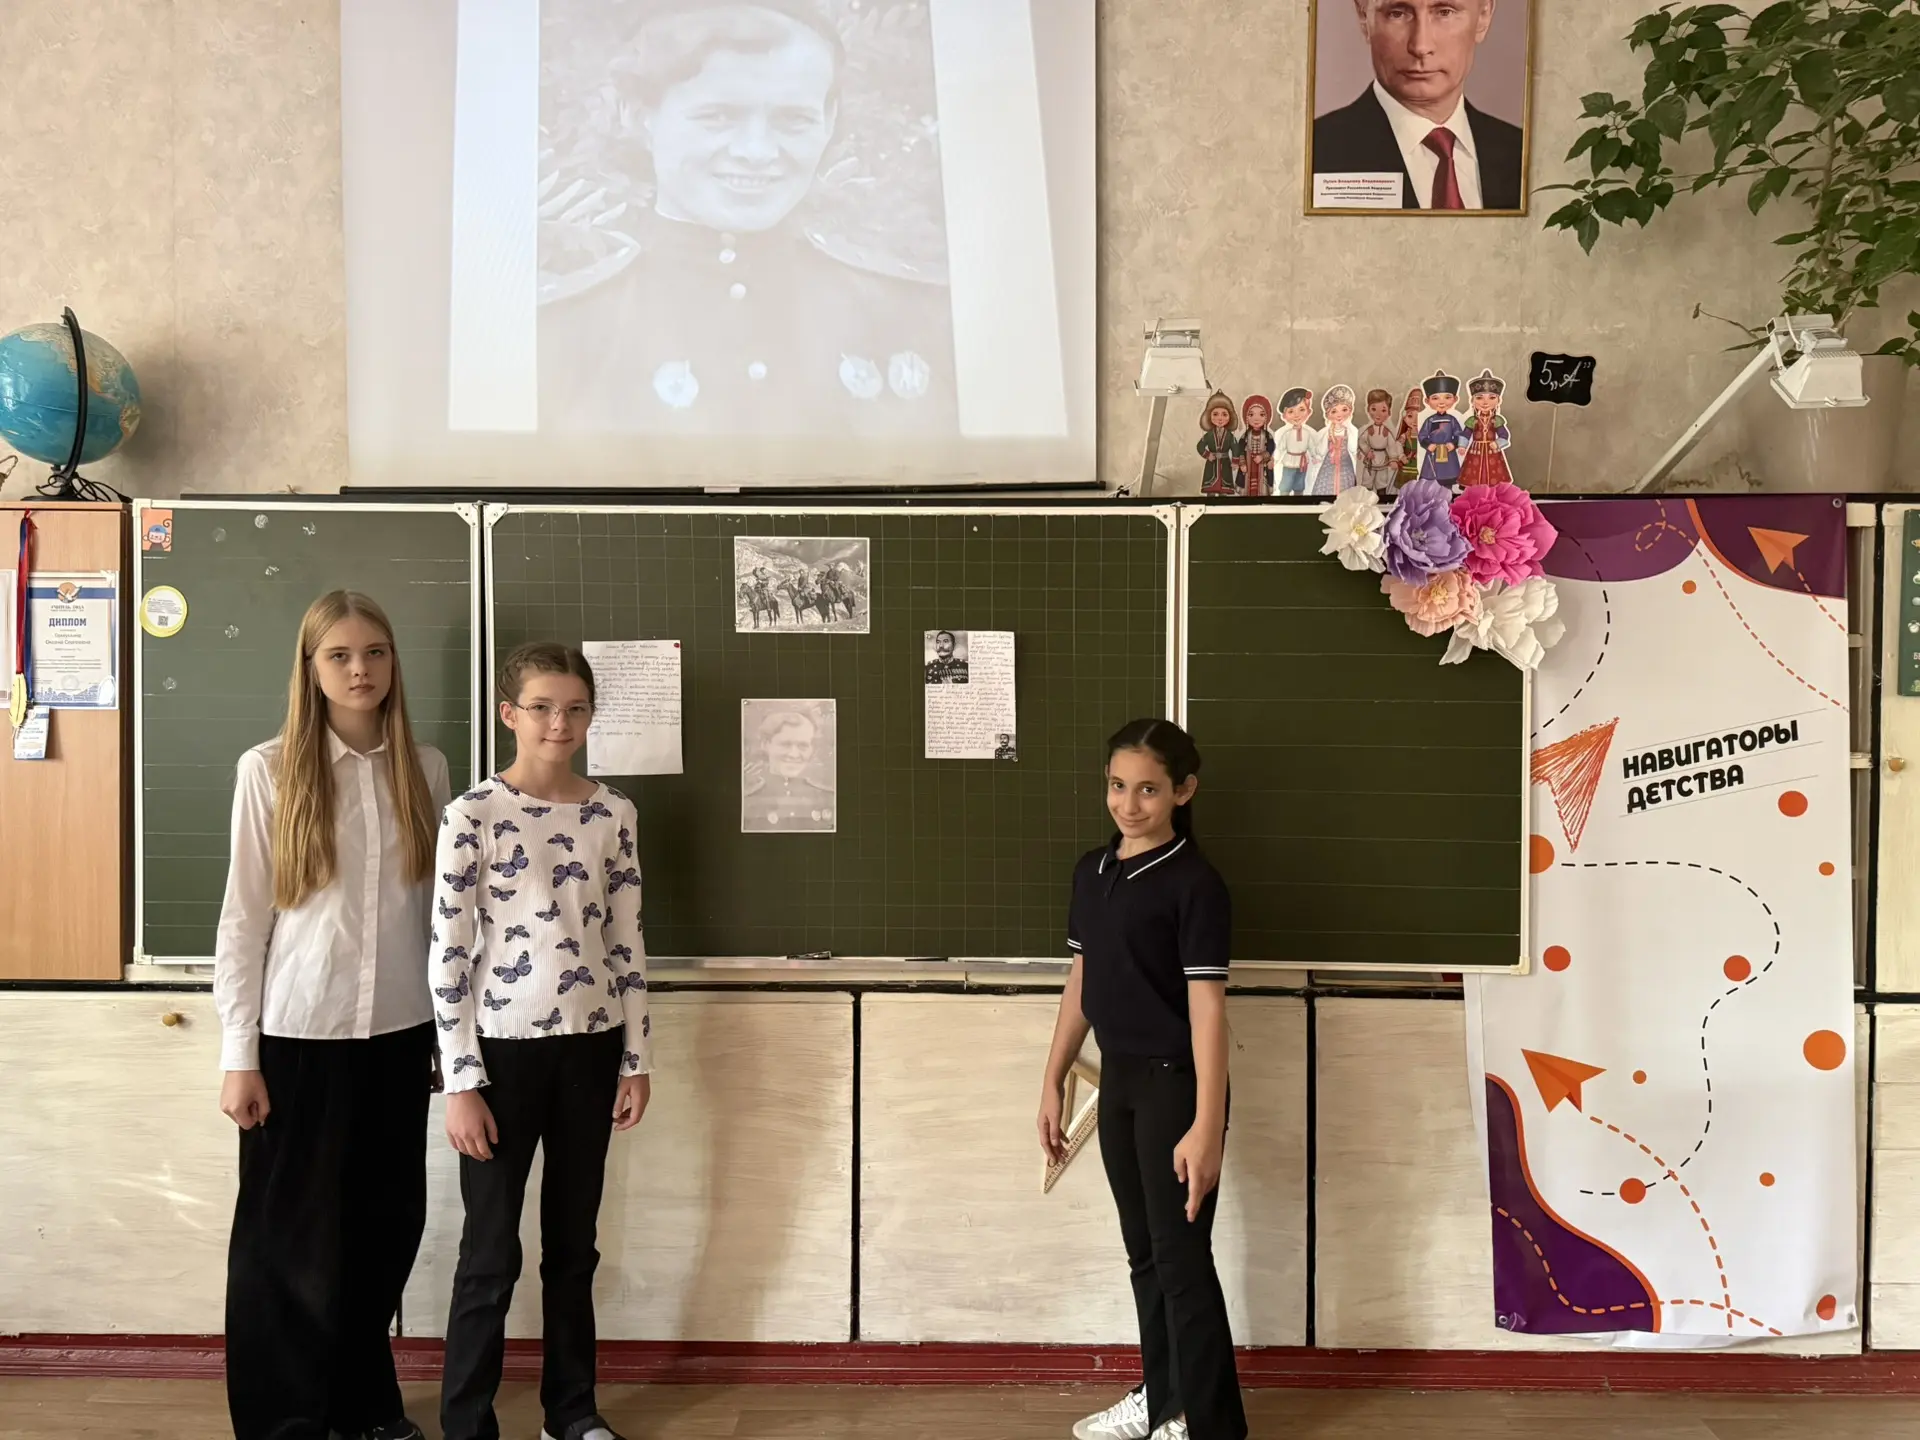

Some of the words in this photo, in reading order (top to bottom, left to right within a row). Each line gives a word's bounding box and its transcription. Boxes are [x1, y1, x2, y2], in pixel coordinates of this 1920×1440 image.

[48, 617, 87, 627] ДИПЛОМ
[1622, 719, 1799, 779] НАВИГАТОРЫ
[1627, 764, 1744, 813] ДЕТСТВА
